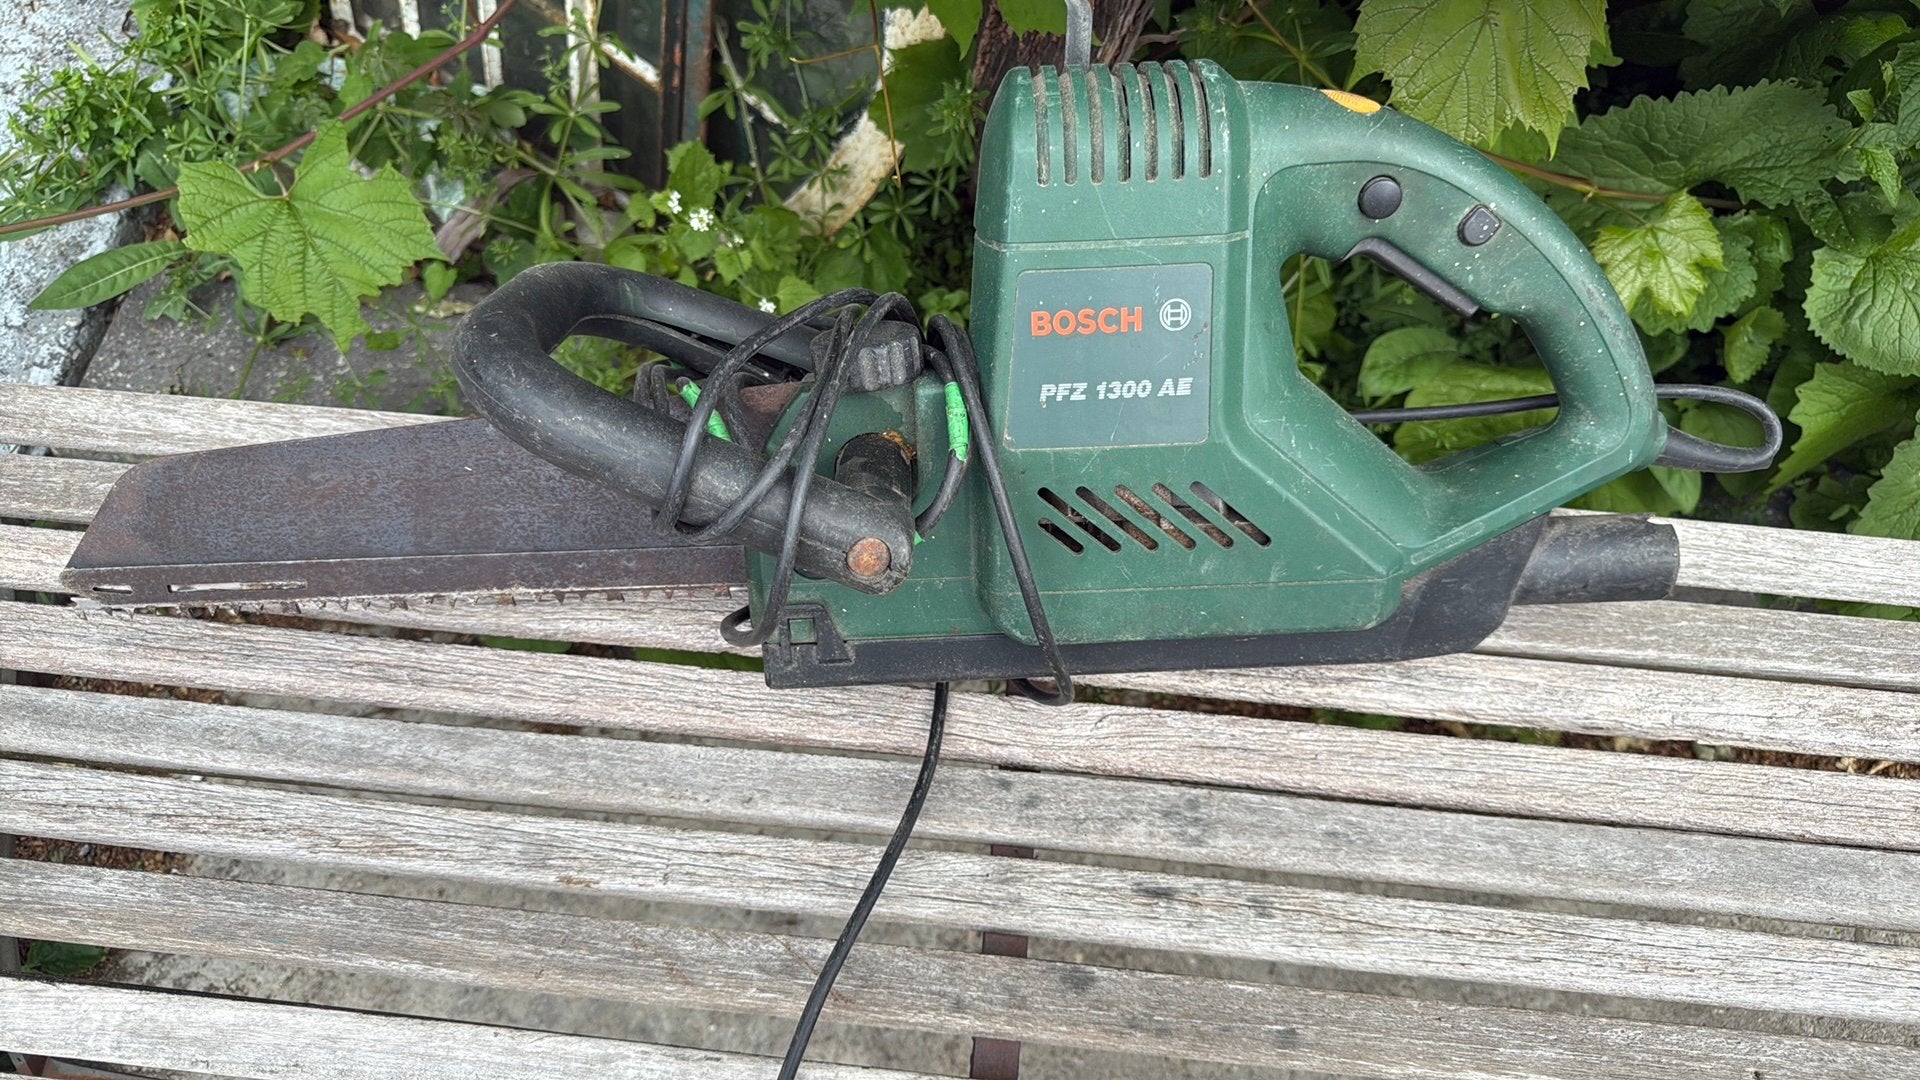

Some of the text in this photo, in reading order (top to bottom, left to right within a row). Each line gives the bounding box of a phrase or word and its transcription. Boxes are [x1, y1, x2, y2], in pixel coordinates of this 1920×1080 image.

[1030, 306, 1142, 336] BOSCH
[1040, 377, 1193, 402] PFZ 1300 AE
